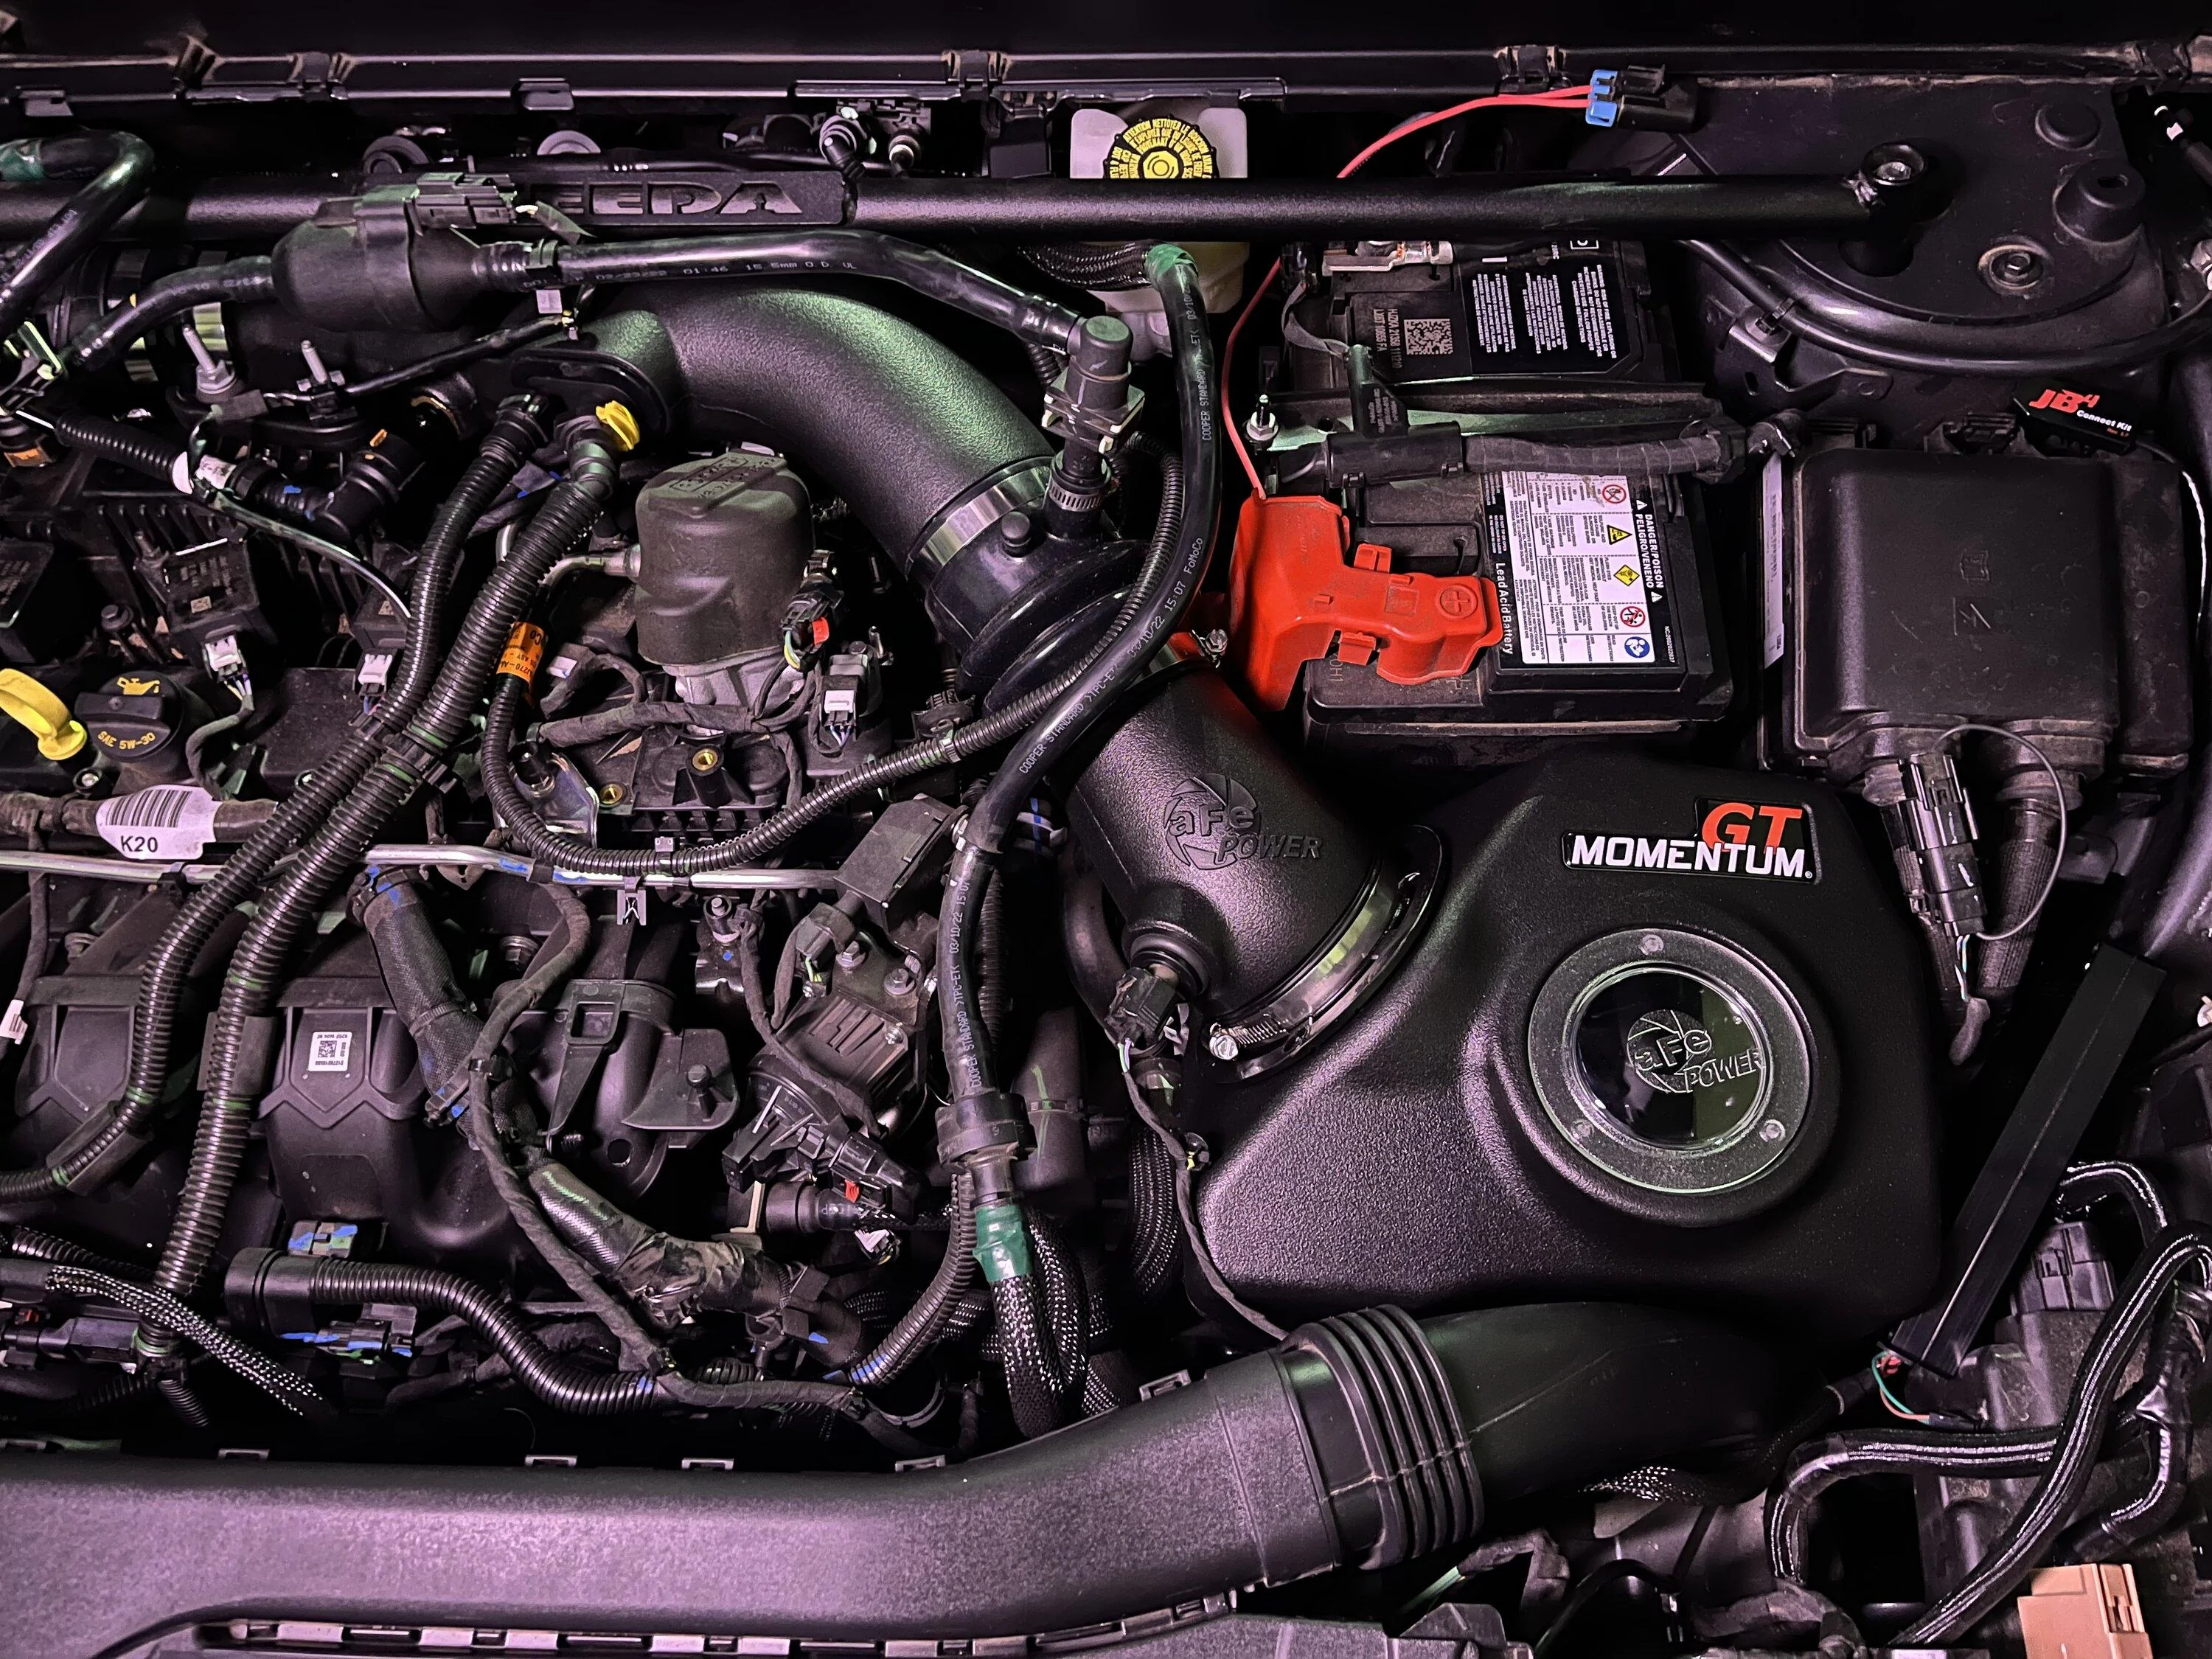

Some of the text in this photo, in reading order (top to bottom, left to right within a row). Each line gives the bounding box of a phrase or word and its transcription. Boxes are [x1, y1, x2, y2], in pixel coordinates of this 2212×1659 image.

[1152, 118, 1181, 131] NETTOYER
[1575, 306, 1586, 342] INSTRUCTIONS
[1583, 308, 1591, 329] FOLLOW
[1590, 307, 1601, 345] RECOMMENDED
[1596, 308, 1607, 342] DISASSEMBLE
[1602, 343, 1609, 351] OR
[1605, 321, 1615, 349] EXPLOSION
[1377, 343, 1388, 352] FA
[1586, 330, 1595, 350] PROPER
[1196, 369, 1210, 406] STANDARD
[2028, 388, 2101, 414] JB4
[1200, 411, 1212, 441] COOPER
[2076, 409, 2132, 432] Connect Kit
[1635, 514, 1654, 588] PELIGRO/VENENO
[1644, 514, 1664, 588] DANGER/POISON
[1495, 563, 1514, 655] Lead Acid Battery
[1019, 743, 1048, 774] COOPER
[1045, 702, 1085, 742] STANDARD
[1164, 581, 1185, 612] 15:07
[1183, 538, 1204, 575] FoMoCo
[97, 730, 156, 750] SAE 5W-30
[1169, 802, 1254, 837] aFe
[1702, 801, 1803, 855] GT
[120, 835, 159, 853] K20
[1214, 832, 1323, 864] POWER
[1571, 835, 1806, 878] MOMENTUM
[950, 911, 963, 953] 03/10/22
[957, 1012, 975, 1052] STANDARD
[1635, 1028, 1712, 1072] aFe
[967, 1054, 982, 1088] COOPER
[1683, 1048, 1765, 1092] POWER
